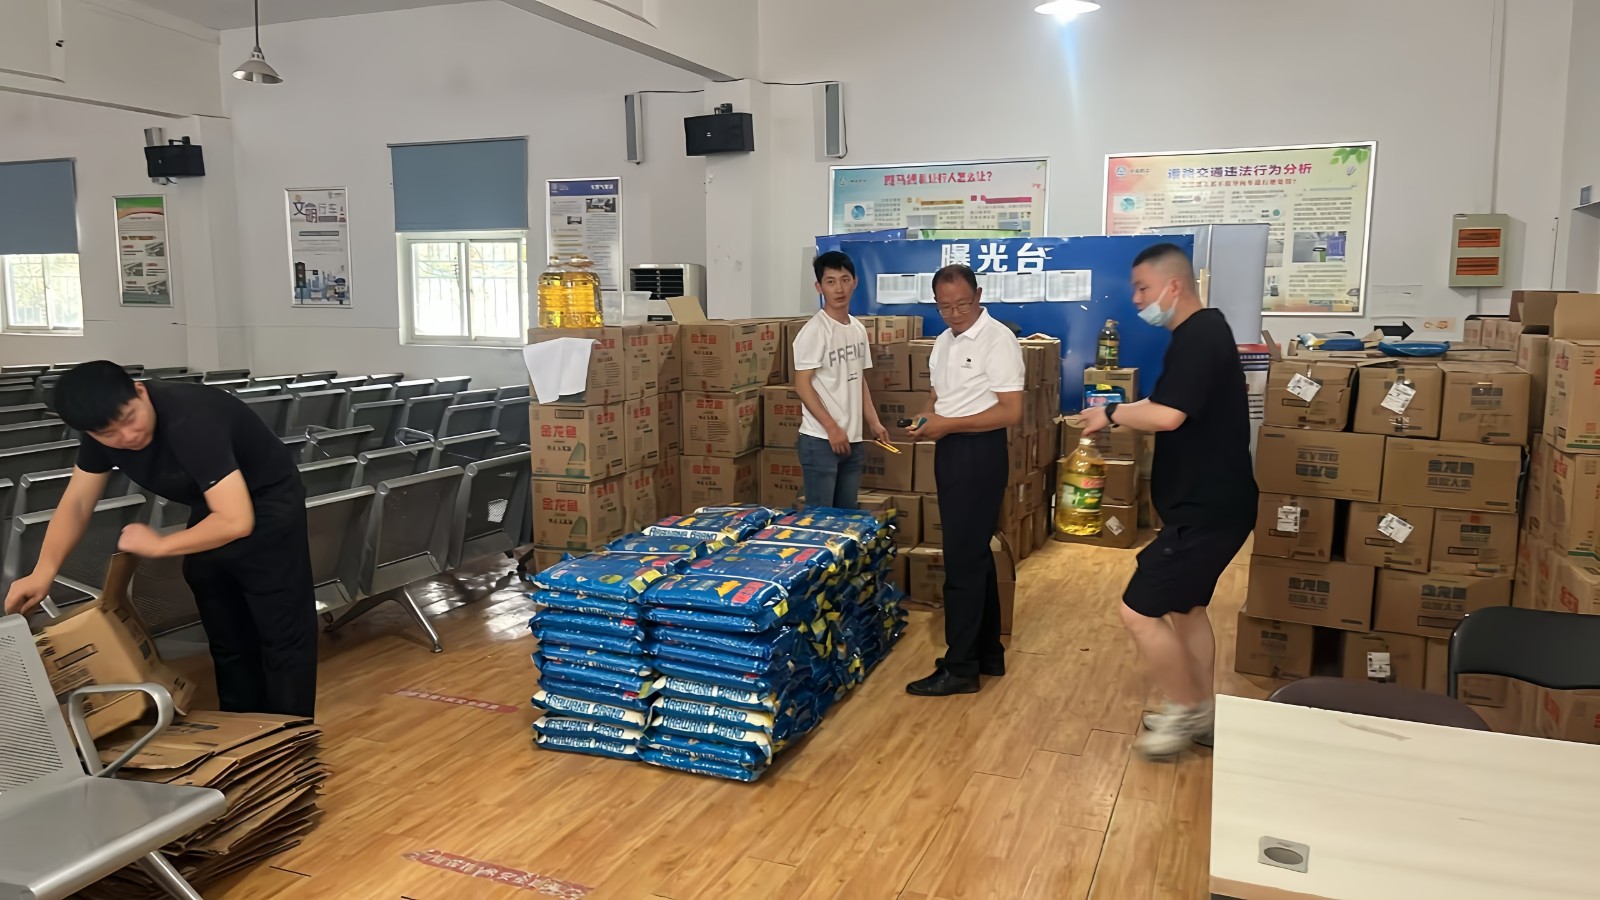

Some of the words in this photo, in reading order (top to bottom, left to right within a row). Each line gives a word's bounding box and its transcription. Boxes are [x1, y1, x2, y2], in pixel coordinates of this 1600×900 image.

[941, 242, 1048, 273] 曝光台
[541, 424, 577, 438] 金龙鱼
